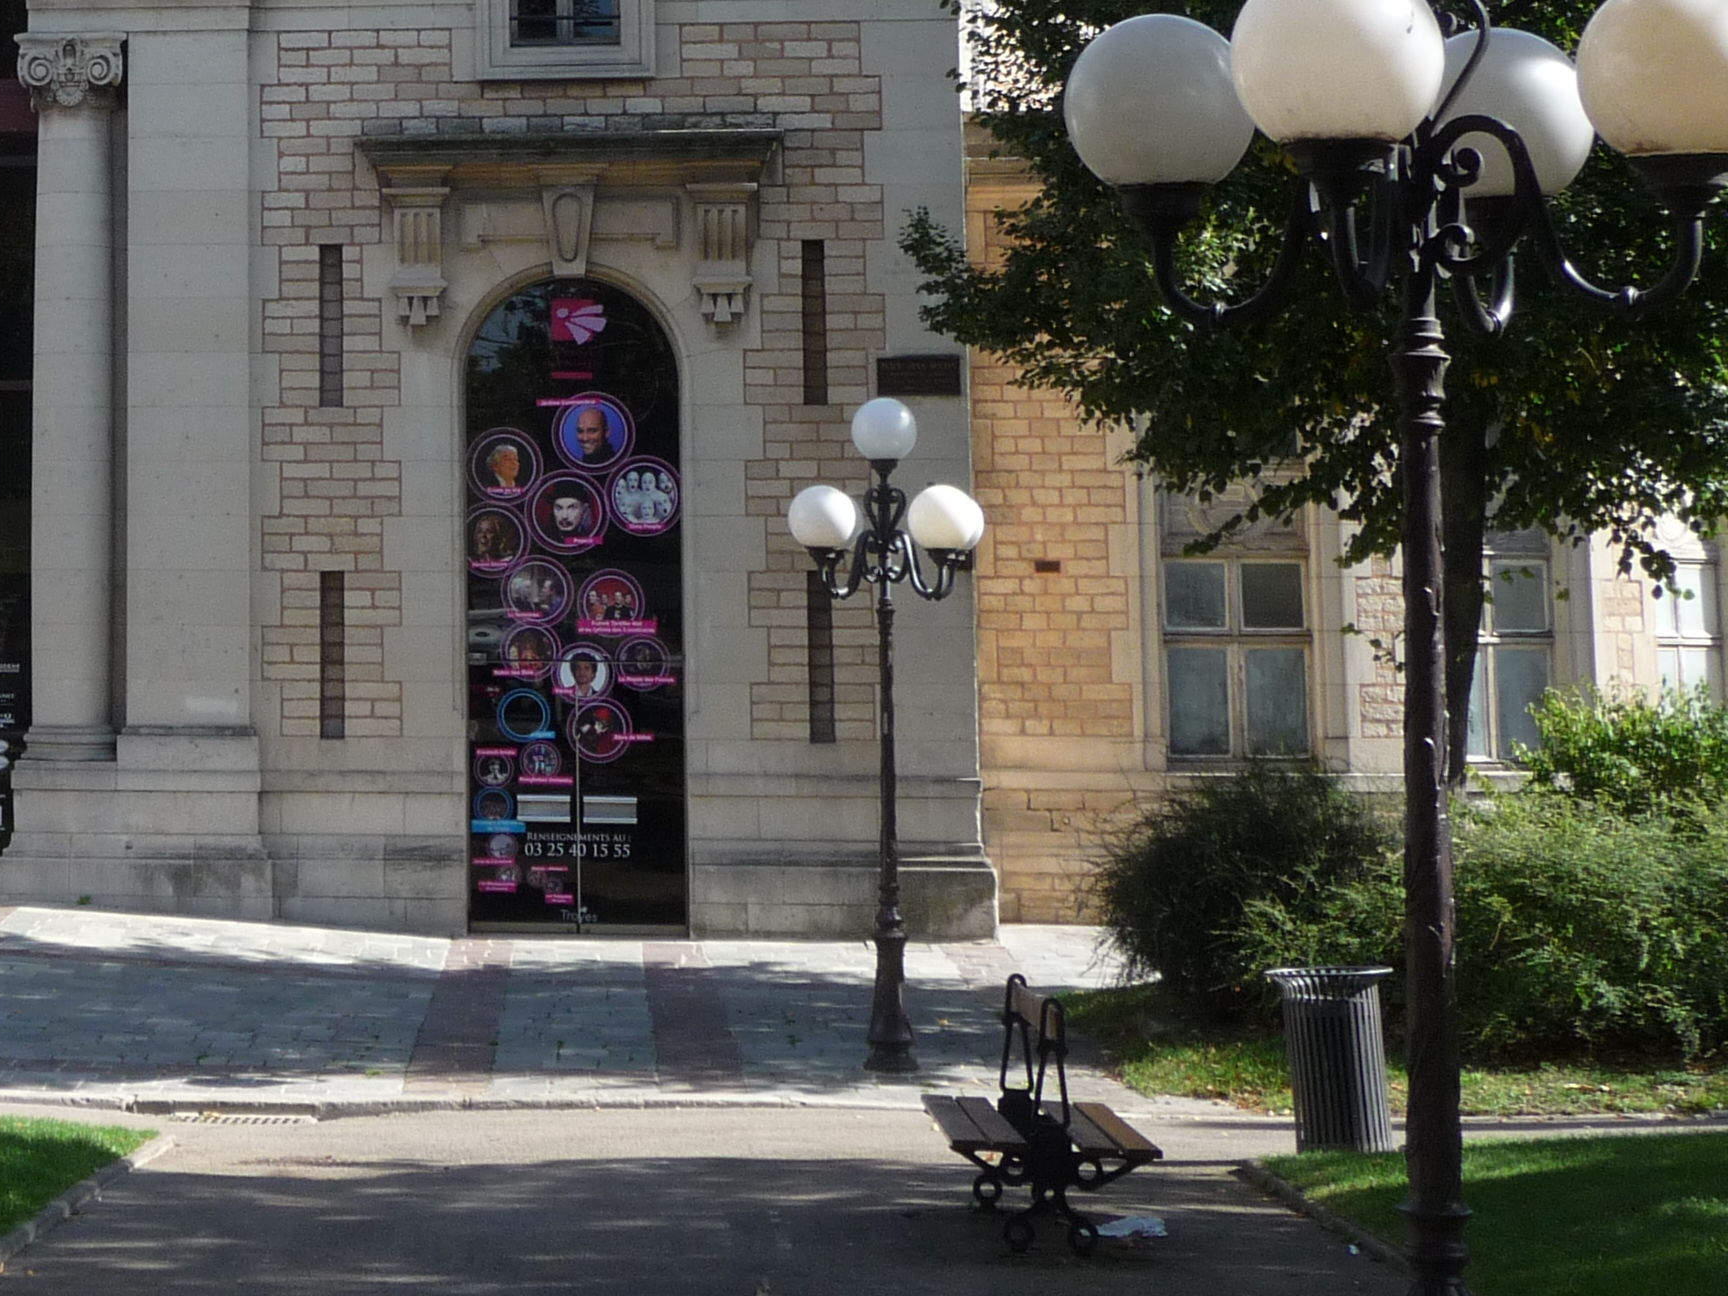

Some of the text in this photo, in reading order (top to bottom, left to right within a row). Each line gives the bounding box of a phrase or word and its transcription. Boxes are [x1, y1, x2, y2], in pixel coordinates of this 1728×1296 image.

[525, 832, 610, 842] RENSEIGNMENTS
[523, 843, 631, 859] 03 25 40 15 55
